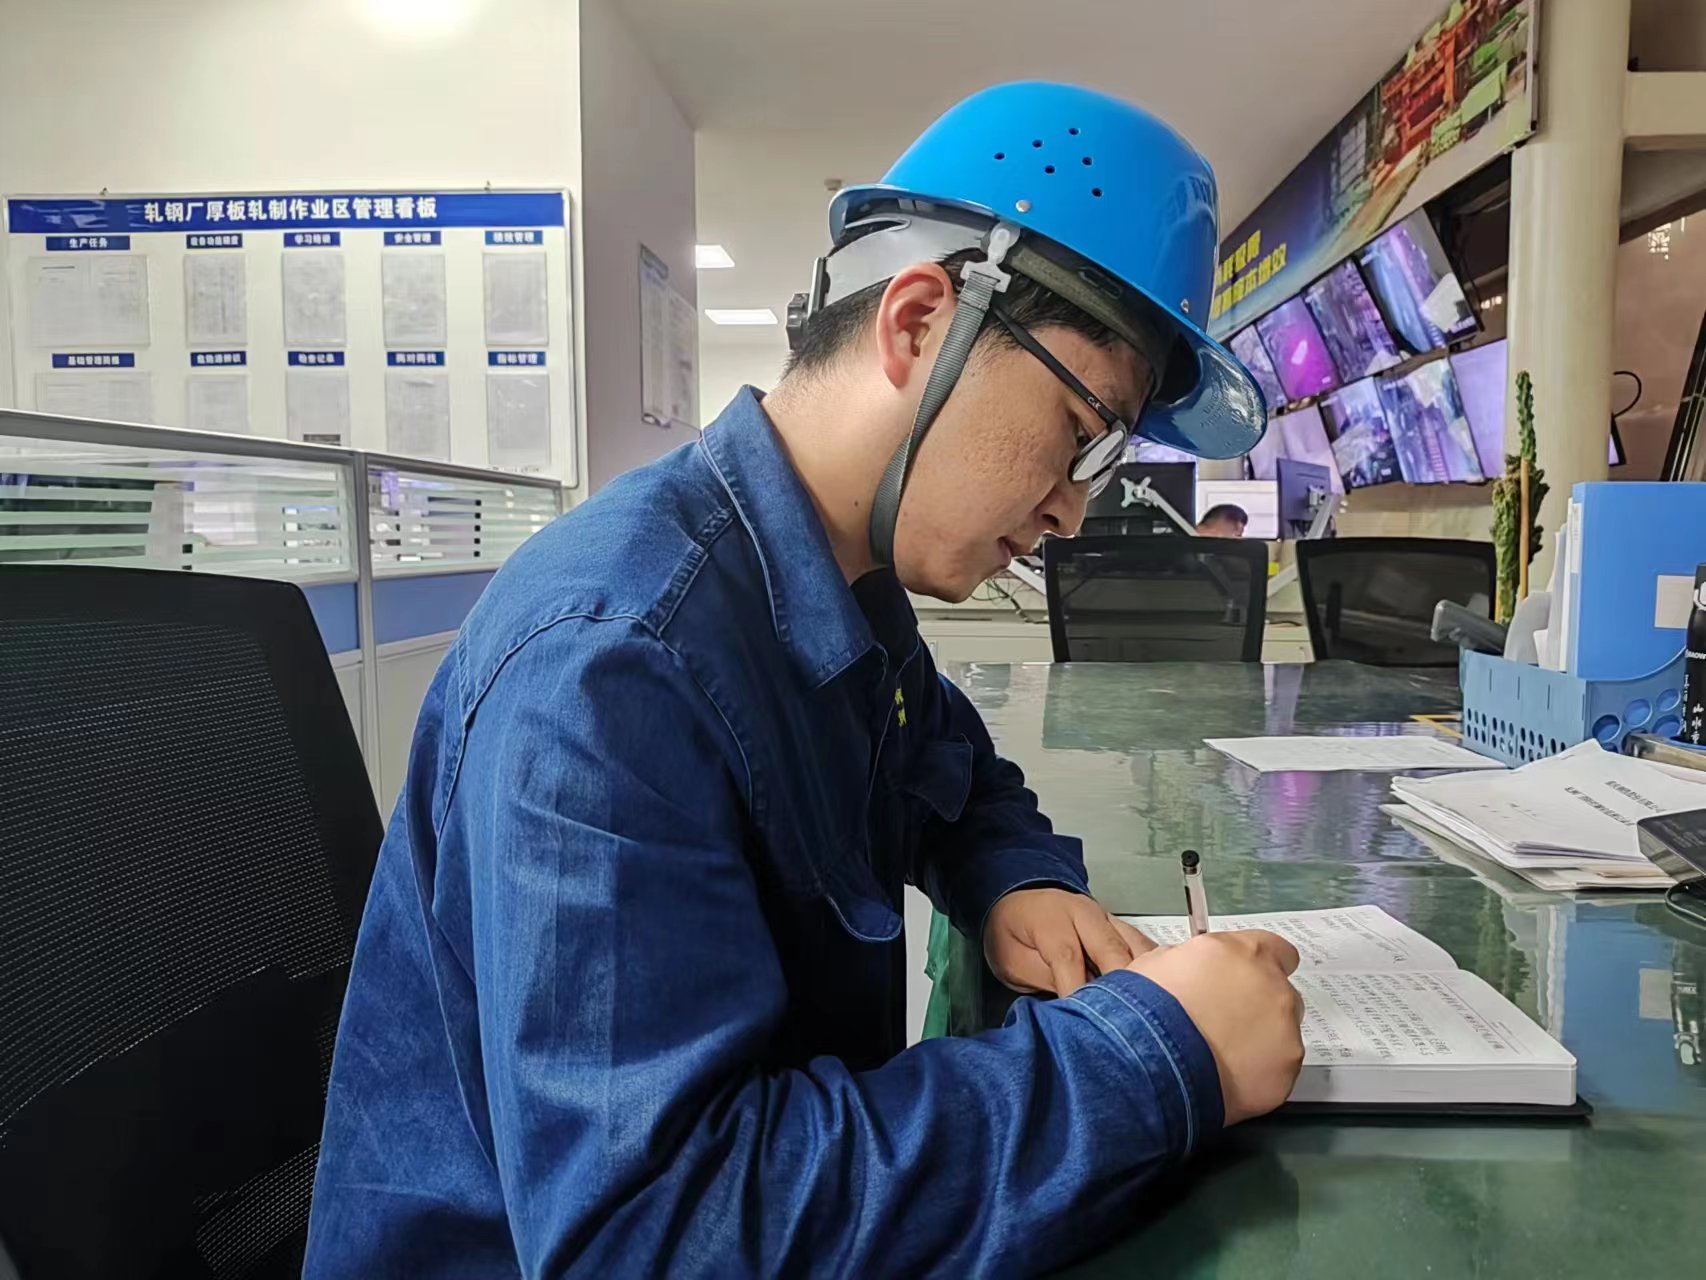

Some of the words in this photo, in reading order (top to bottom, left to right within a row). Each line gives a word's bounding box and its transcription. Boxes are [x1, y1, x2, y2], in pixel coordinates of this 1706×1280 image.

[144, 197, 437, 222] 轧钢厂厚板轧制作业区管理看板
[69, 238, 108, 249] 生产任务
